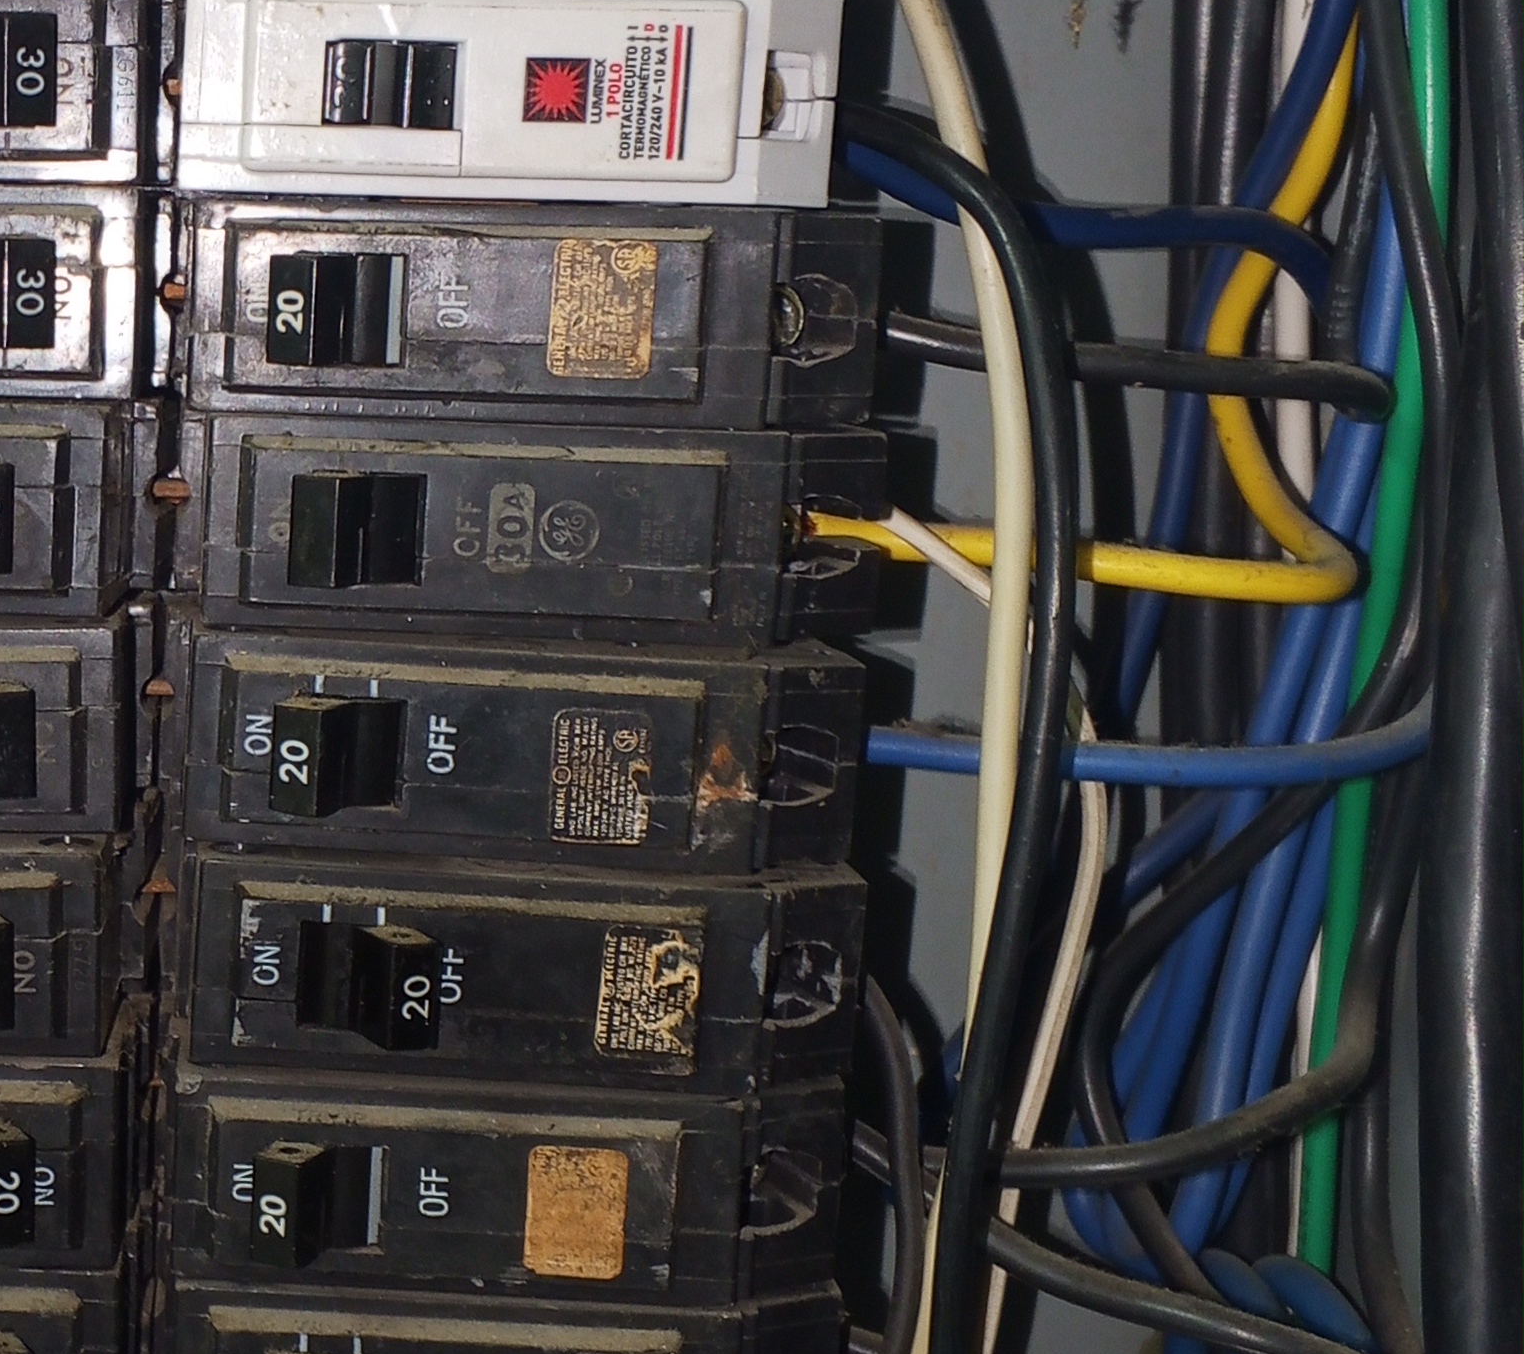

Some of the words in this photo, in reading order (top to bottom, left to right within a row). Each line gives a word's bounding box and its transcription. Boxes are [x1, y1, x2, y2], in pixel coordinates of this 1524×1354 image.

[15, 45, 45, 97] 30
[654, 47, 668, 65] kA
[589, 58, 607, 124] LUMINEX
[606, 63, 623, 105] POLO
[618, 45, 637, 160] CORTACIRCUITO
[648, 106, 663, 161] 120/240
[15, 267, 45, 318] 30
[275, 289, 304, 335] 20
[437, 276, 469, 329] OFF
[244, 714, 272, 756] ON
[427, 714, 458, 774] OFF
[558, 718, 570, 765] ELECTRIC
[279, 740, 310, 785] 20
[14, 949, 36, 994] ON
[252, 944, 281, 985] ON
[402, 975, 431, 1022] 20
[34, 1166, 55, 1208] ON
[419, 1166, 450, 1218] OFF
[258, 1194, 288, 1238] 20
